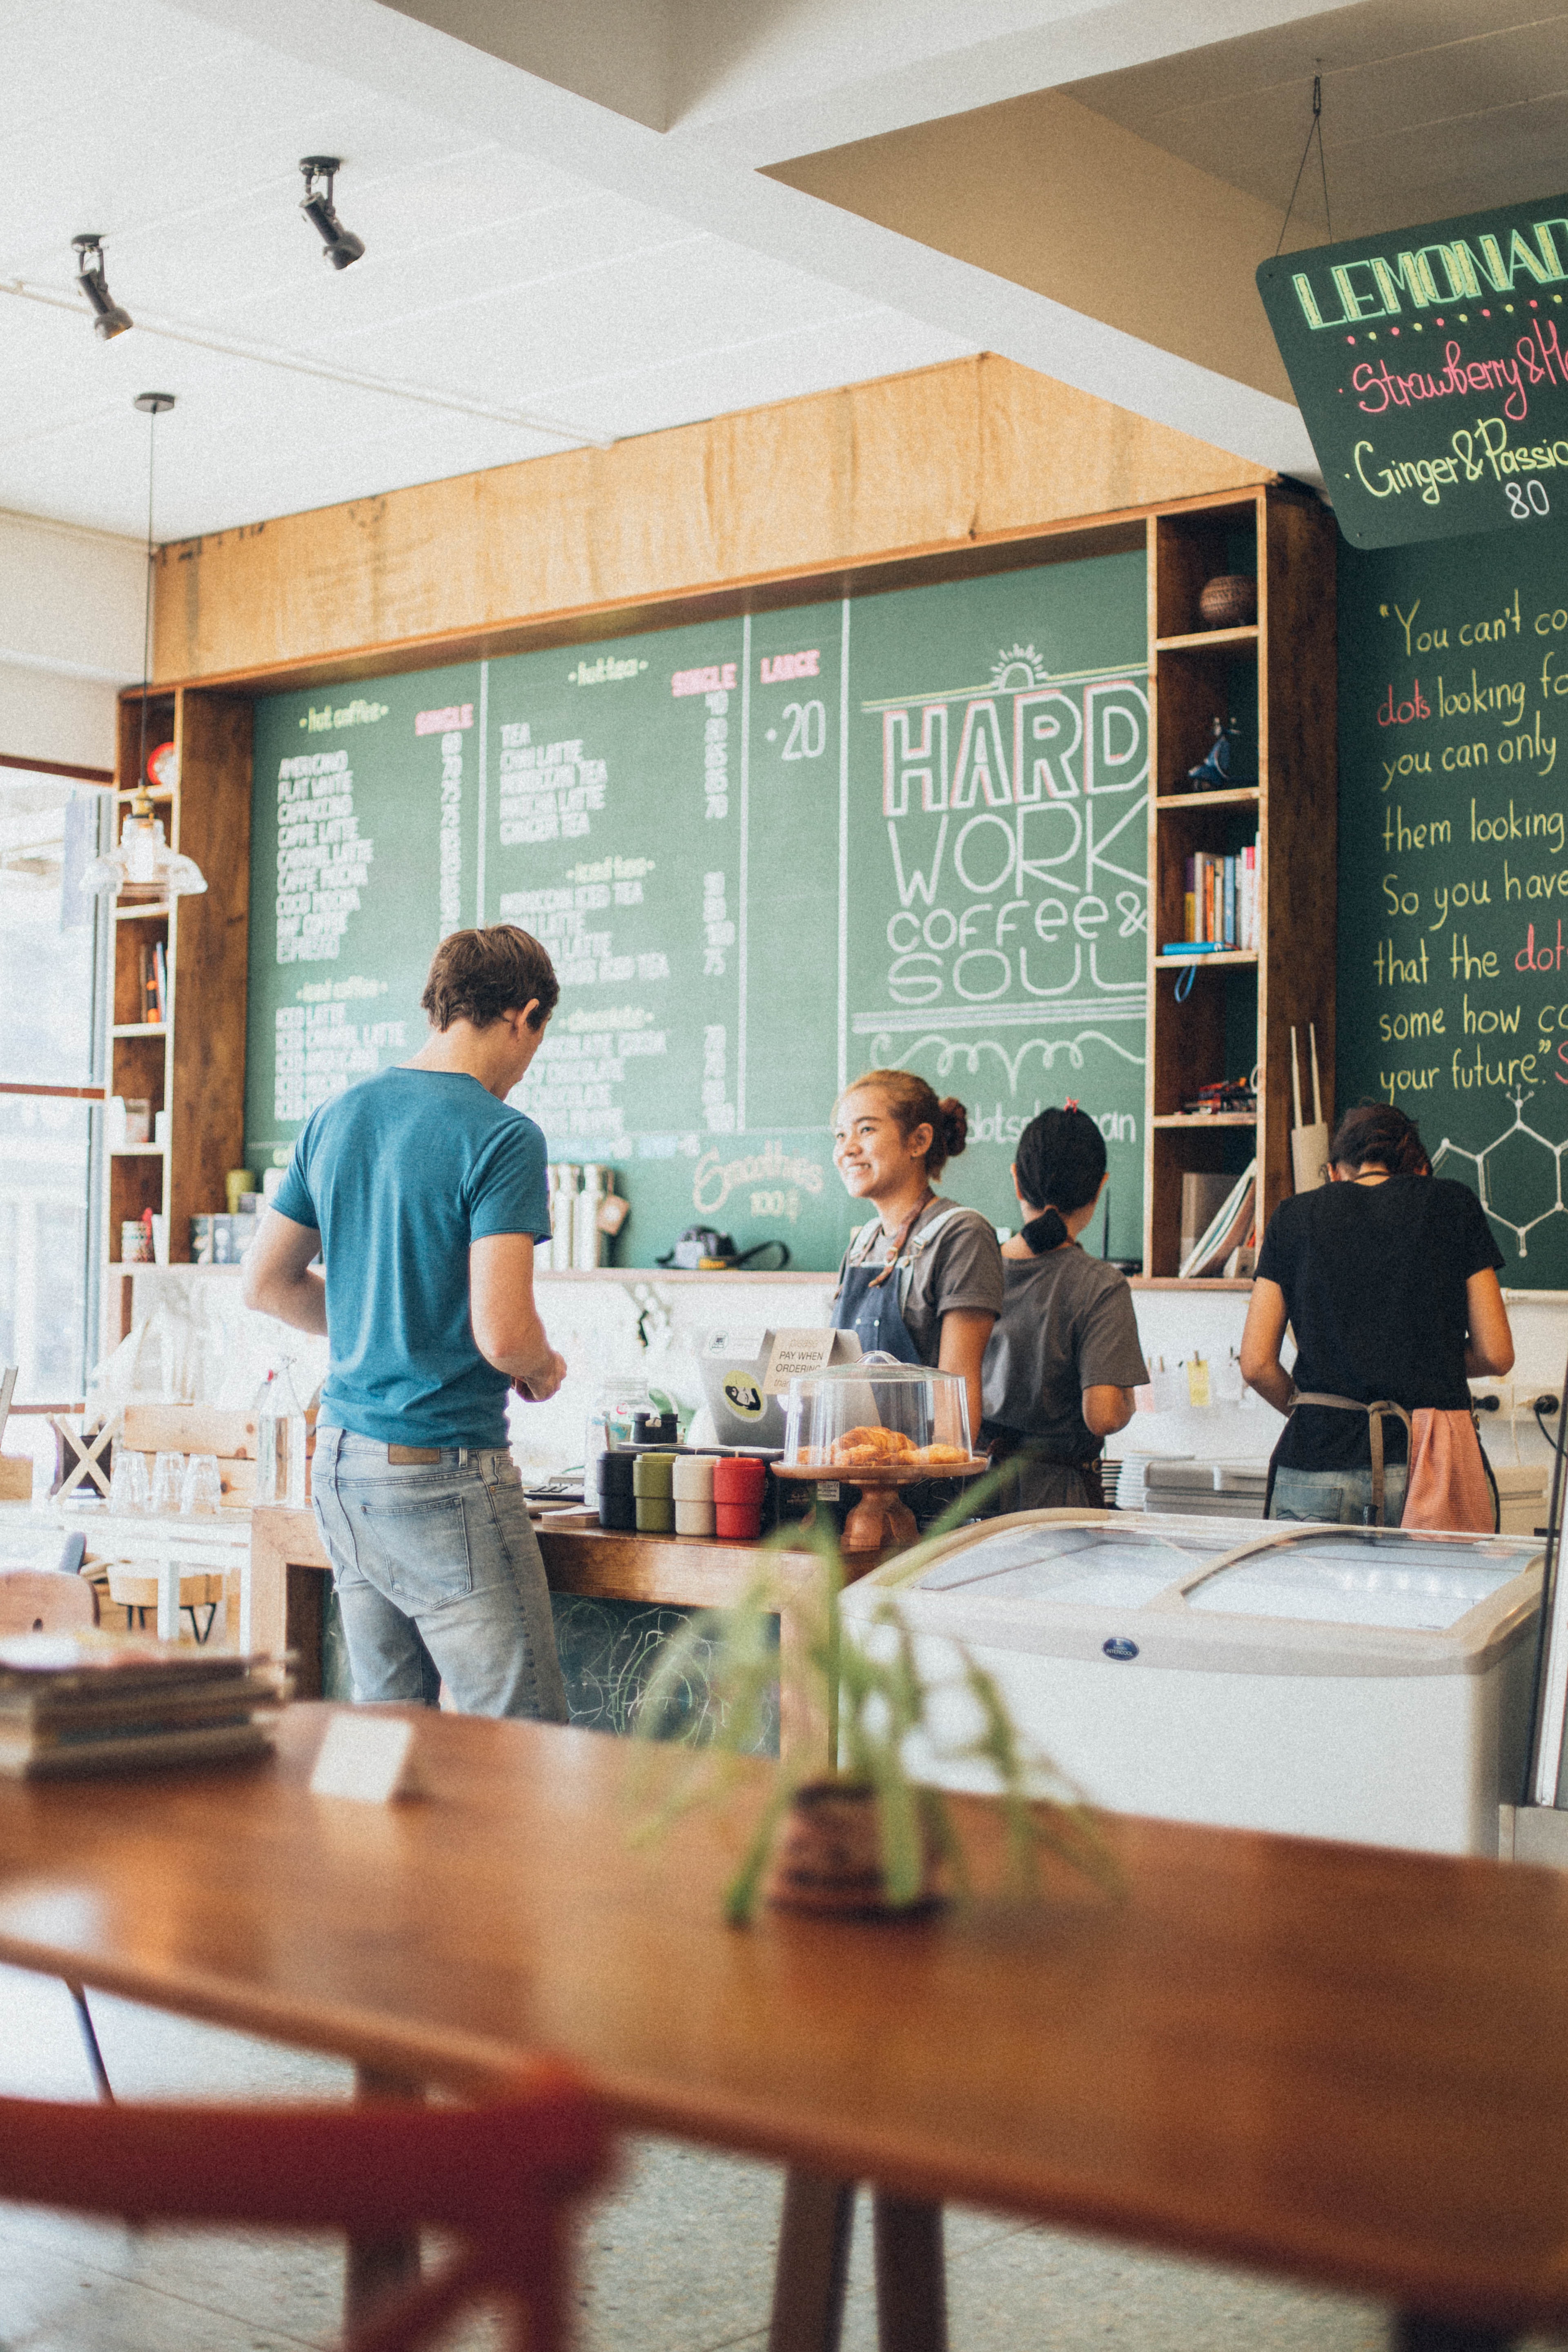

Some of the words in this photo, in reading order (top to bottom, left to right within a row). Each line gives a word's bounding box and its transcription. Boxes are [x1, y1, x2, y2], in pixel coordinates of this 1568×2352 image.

[1506, 480, 1549, 519] 80
[1459, 588, 1521, 646] can't
[1376, 679, 1430, 726] dots
[1438, 668, 1525, 726] looking
[882, 679, 1149, 817] HARD
[1381, 751, 1432, 791] you
[1442, 742, 1488, 771] can
[1498, 710, 1556, 776] only
[887, 793, 1149, 907] WORK
[1383, 805, 1450, 852] them
[1472, 798, 1565, 853] looking
[1383, 874, 1419, 915] So
[1429, 880, 1491, 931] you
[1504, 859, 1568, 901] have
[888, 942, 1147, 1004] SOUL
[1374, 938, 1429, 985] that
[1450, 933, 1500, 980] the
[1515, 918, 1568, 971] dot
[1379, 1007, 1445, 1041] some
[1464, 993, 1521, 1034] how
[1380, 1067, 1440, 1106] your
[779, 1351, 796, 1359] PAY
[798, 1352, 824, 1361] WHEN
